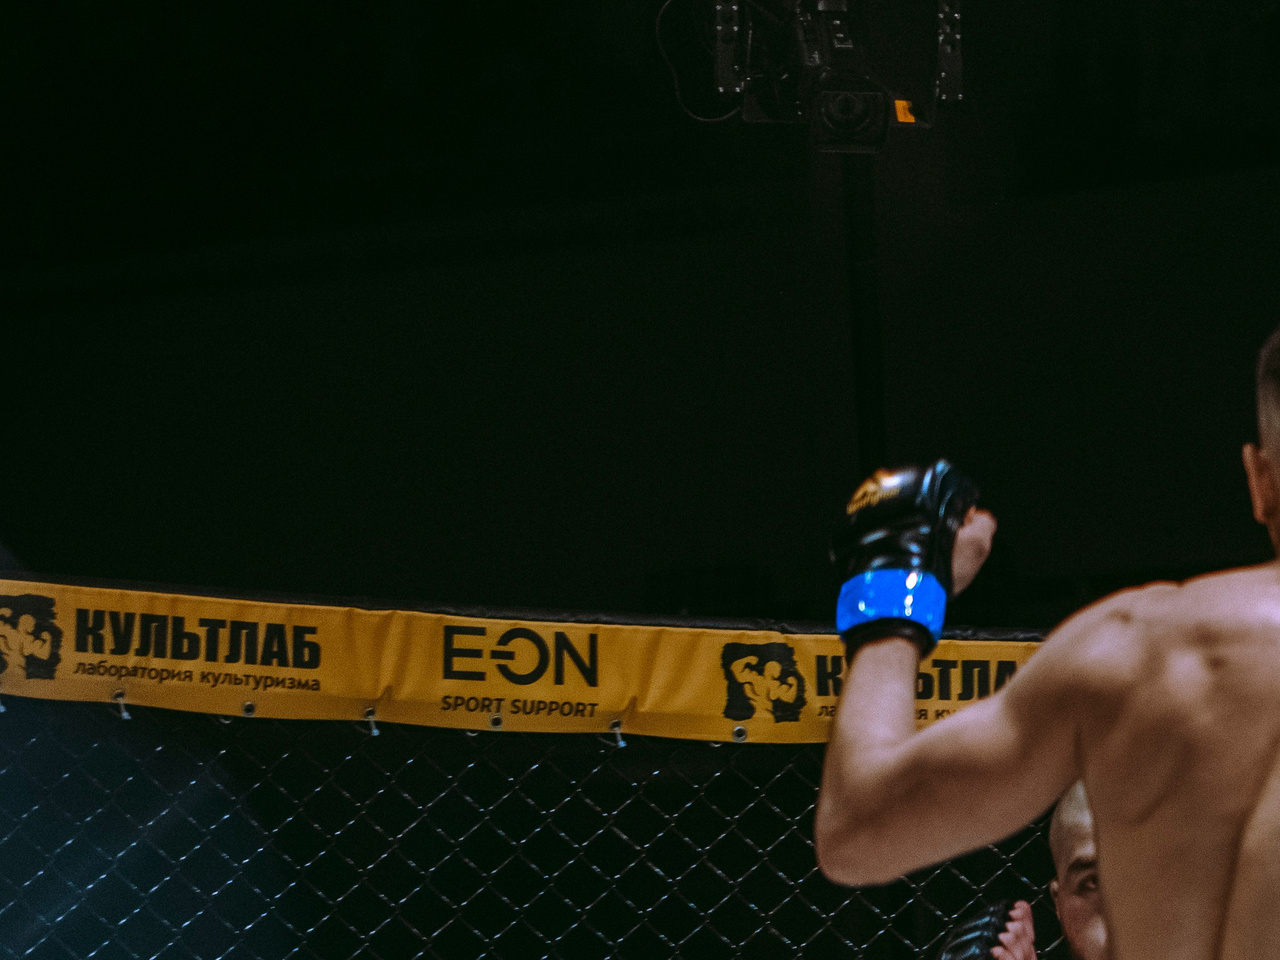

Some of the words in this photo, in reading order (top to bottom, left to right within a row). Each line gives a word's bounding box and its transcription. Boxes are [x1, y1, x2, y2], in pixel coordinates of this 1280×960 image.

[76, 608, 321, 670] КУЛЬТЛАБ
[73, 660, 193, 684] лаборатория
[200, 669, 321, 692] культуризма
[441, 695, 506, 713] SPORT
[510, 698, 599, 718] SUPPORT
